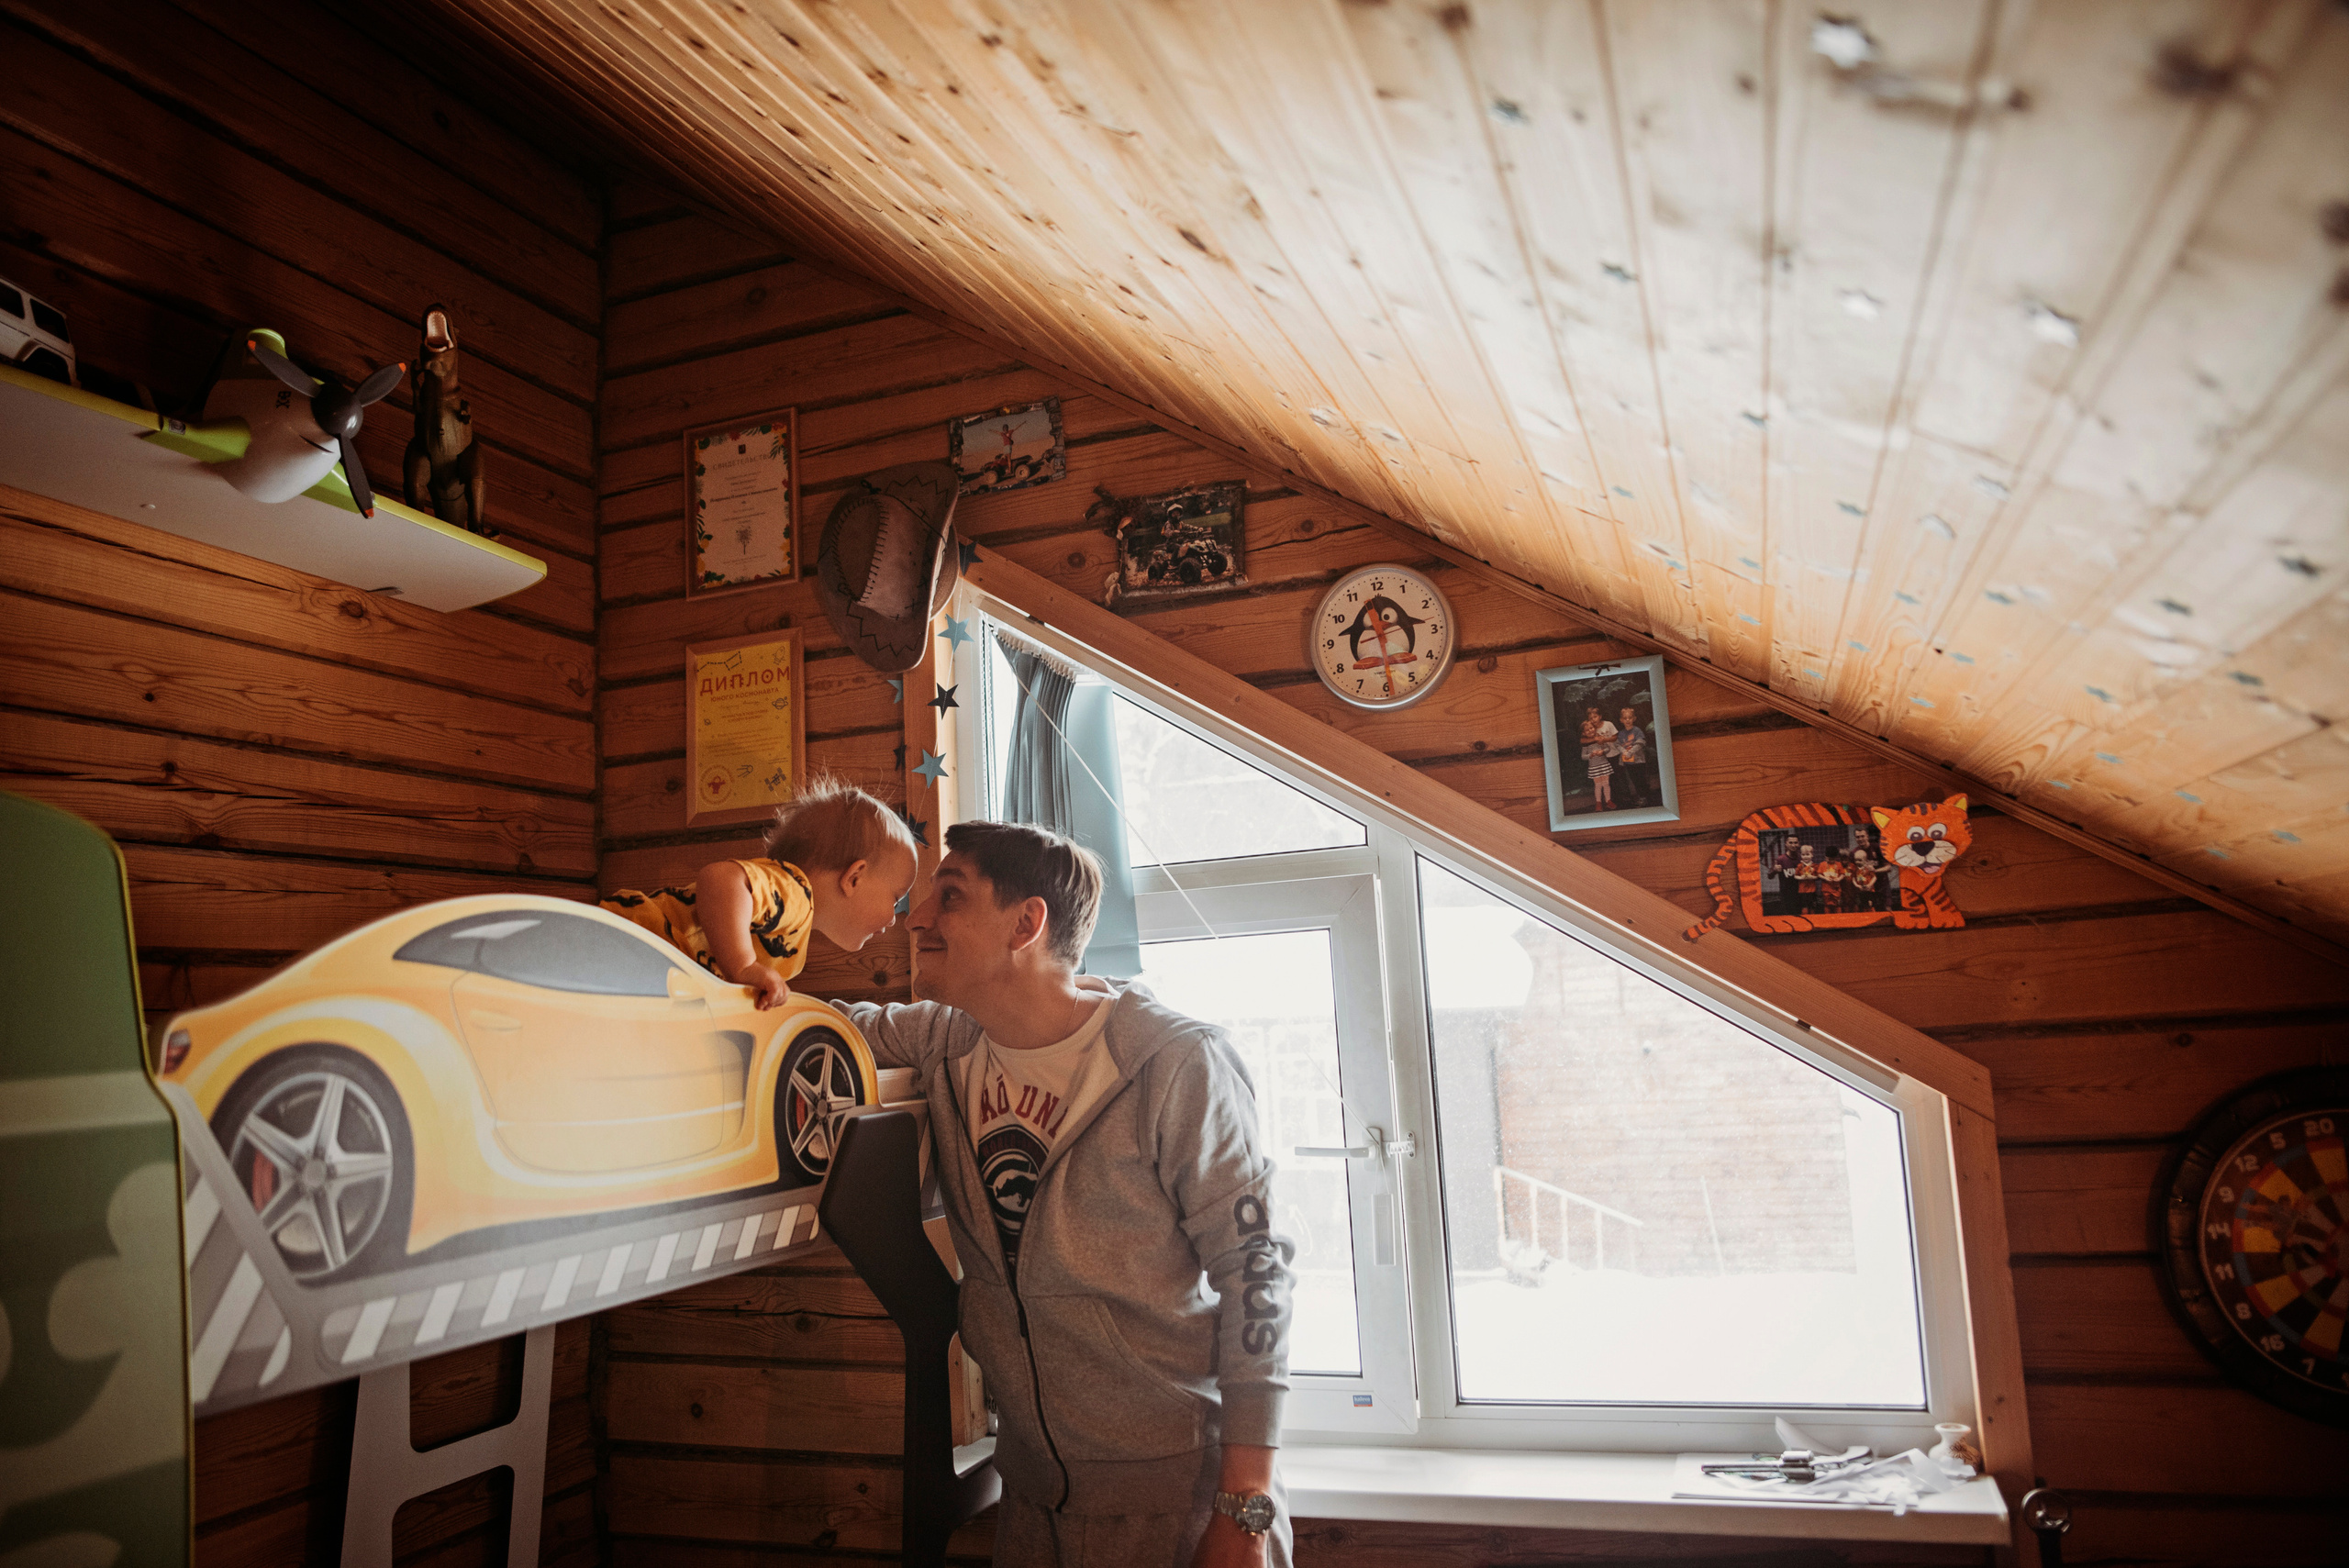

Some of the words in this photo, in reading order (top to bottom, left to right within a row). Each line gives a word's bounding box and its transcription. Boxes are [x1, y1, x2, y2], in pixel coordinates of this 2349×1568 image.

[1371, 582, 1384, 592] 12
[1399, 584, 1406, 594] 1
[1346, 593, 1358, 602] 11
[1421, 599, 1430, 609] 2
[1332, 614, 1345, 624] 10
[1431, 624, 1439, 634] 3
[1327, 639, 1335, 650] 9
[1426, 650, 1434, 659] 4
[1336, 663, 1344, 673] 8
[699, 666, 790, 696] ДИПЛОМ
[1357, 679, 1364, 689] 7
[1408, 672, 1416, 683] 5
[1382, 682, 1390, 692] 6
[710, 693, 734, 703] ЮНОГО
[735, 686, 779, 699] КОСМОНАВТА
[2304, 1117, 2335, 1138] 20
[2269, 1131, 2287, 1151] 5
[2234, 1154, 2260, 1173] 12
[2219, 1186, 2235, 1204] 9
[2207, 1222, 2232, 1240] 14
[1234, 1195, 1281, 1355] adas
[2214, 1263, 2235, 1282] 11
[2235, 1302, 2253, 1320] 8
[2260, 1334, 2286, 1353] 16
[2300, 1357, 2315, 1375] 7
